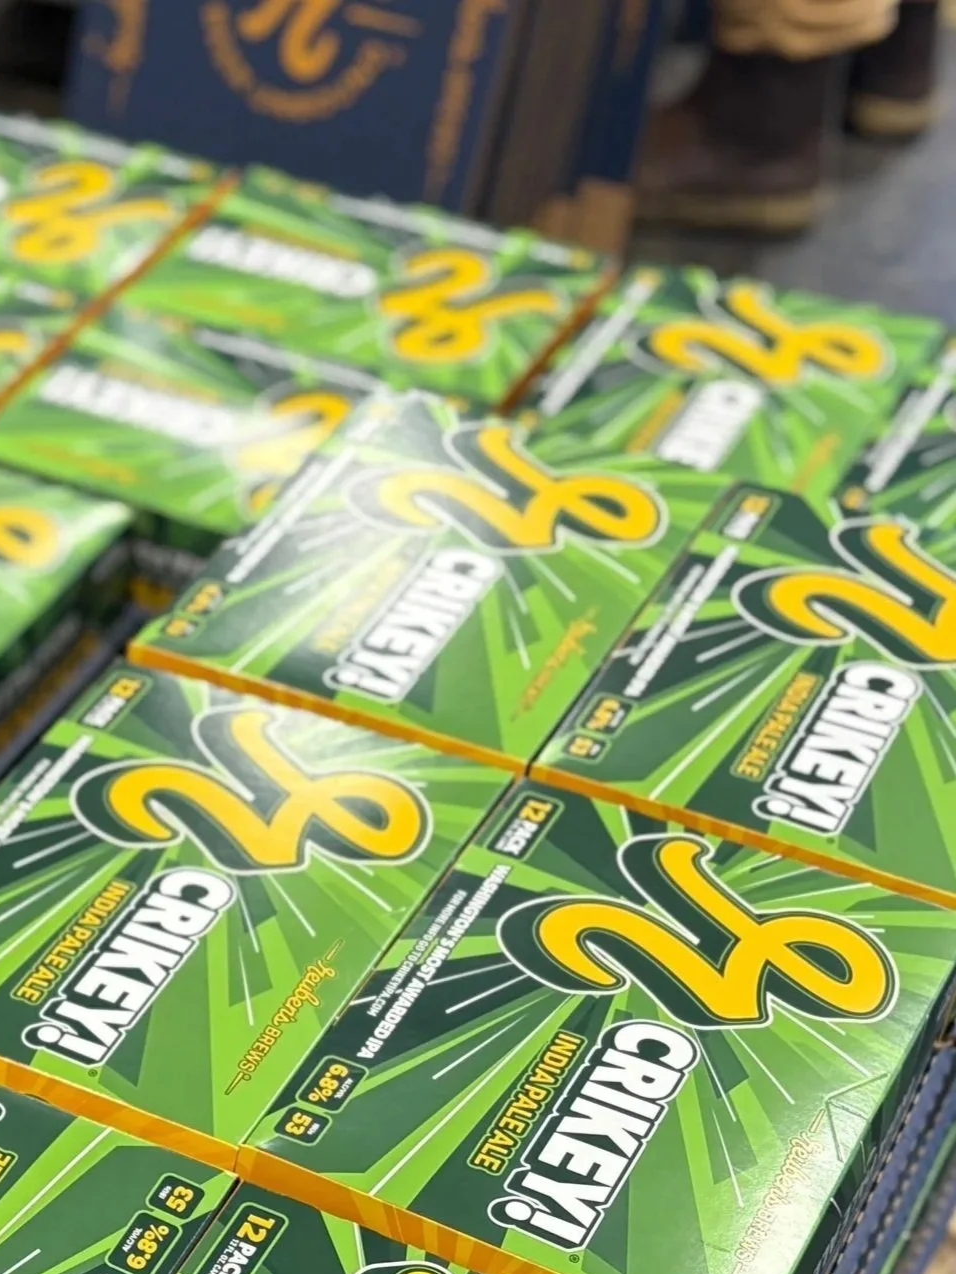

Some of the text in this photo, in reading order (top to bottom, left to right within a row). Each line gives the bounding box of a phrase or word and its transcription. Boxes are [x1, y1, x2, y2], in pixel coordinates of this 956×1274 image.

[759, 662, 920, 833] CRIKEY!
[519, 800, 552, 823] 12
[504, 822, 538, 855] PACK
[440, 864, 511, 950] WASHINGTON'S
[16, 880, 130, 1003] INDIA PALE ALE
[416, 942, 449, 983] MOST
[30, 868, 235, 1064] CRIKEY!
[374, 977, 427, 1045] AWARDED
[238, 1025, 283, 1073] BREWS
[357, 1034, 381, 1059] IPA
[308, 1063, 349, 1103] 6.8%
[474, 1033, 581, 1173] INDIA PALE ALE
[285, 1112, 313, 1135] 53
[496, 1021, 697, 1247] CRIKEY!
[165, 1186, 194, 1213] 53
[122, 1227, 143, 1252] ALC/VOL
[126, 1224, 170, 1270] 6.8%
[236, 1213, 276, 1243] 12
